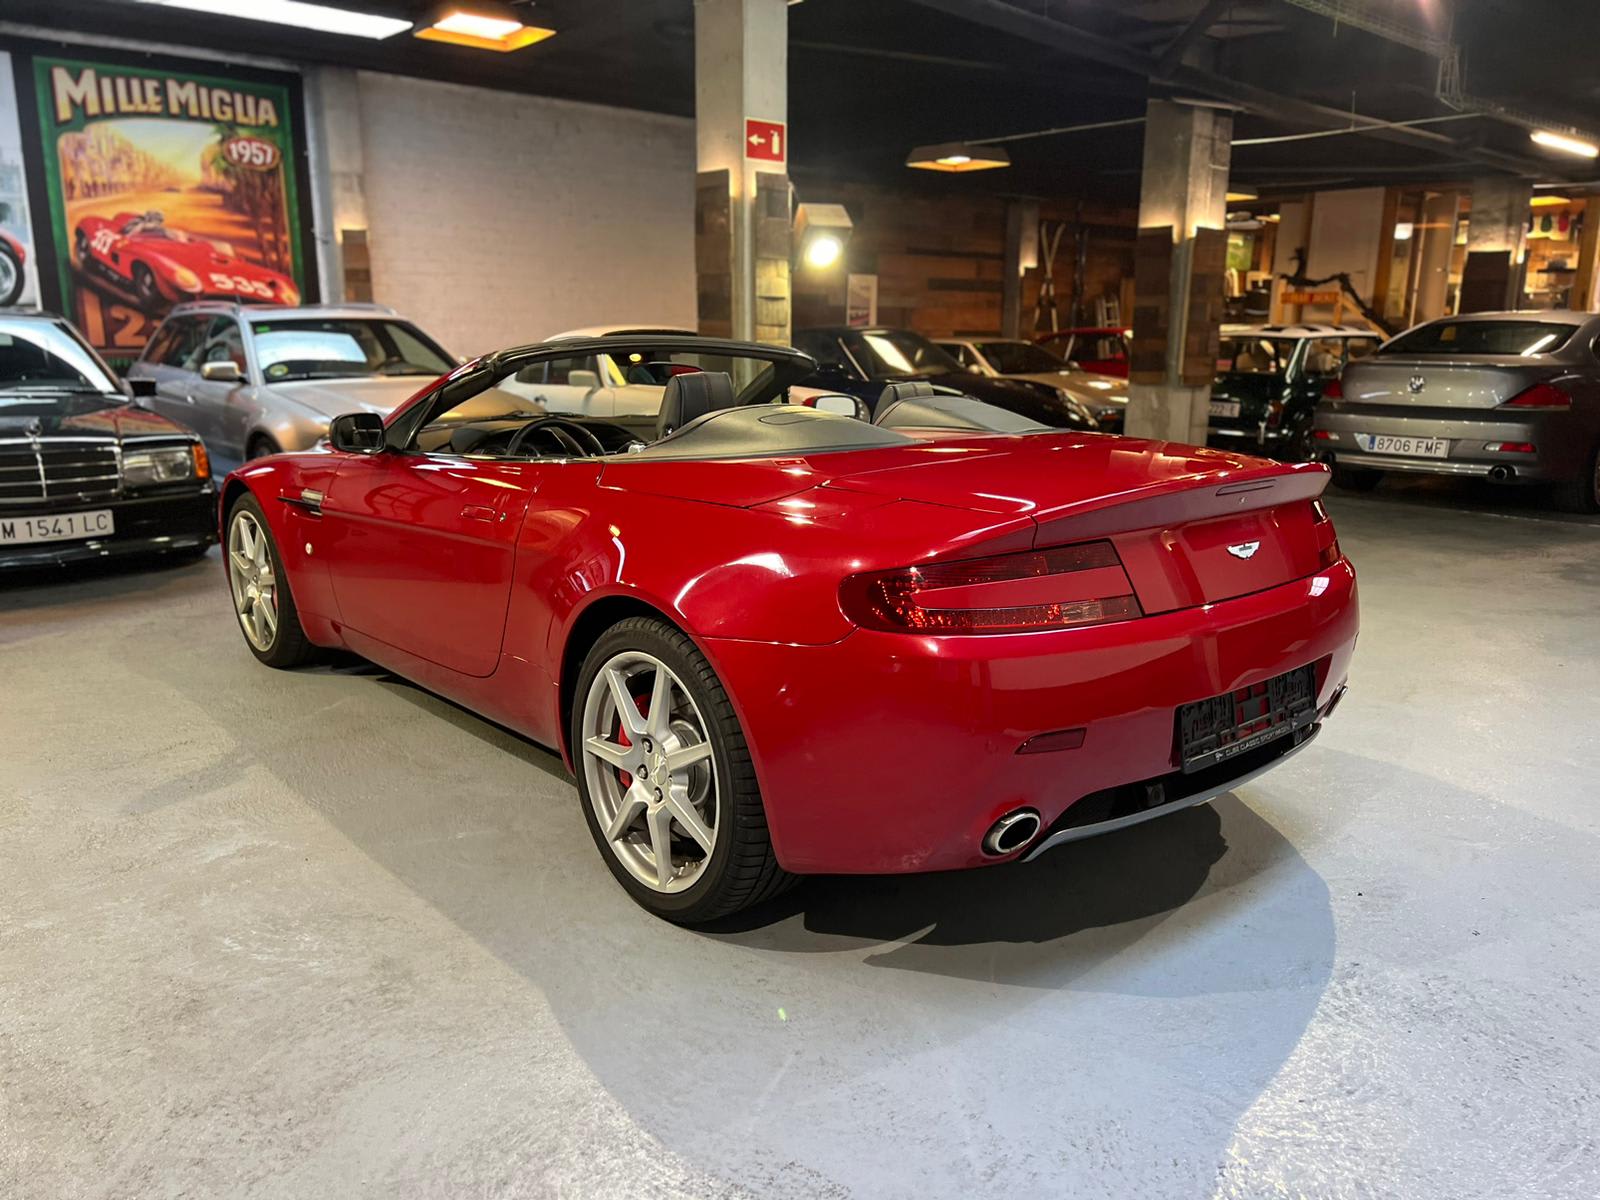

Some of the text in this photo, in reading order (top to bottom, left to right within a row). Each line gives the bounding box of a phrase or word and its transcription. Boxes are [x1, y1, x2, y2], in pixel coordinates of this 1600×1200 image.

[51, 66, 279, 127] MILLE MIGLIA
[229, 142, 272, 165] 1957
[208, 272, 275, 299] 535
[1377, 438, 1444, 455] 8706 FMF
[1, 513, 108, 540] M 1541 LC
